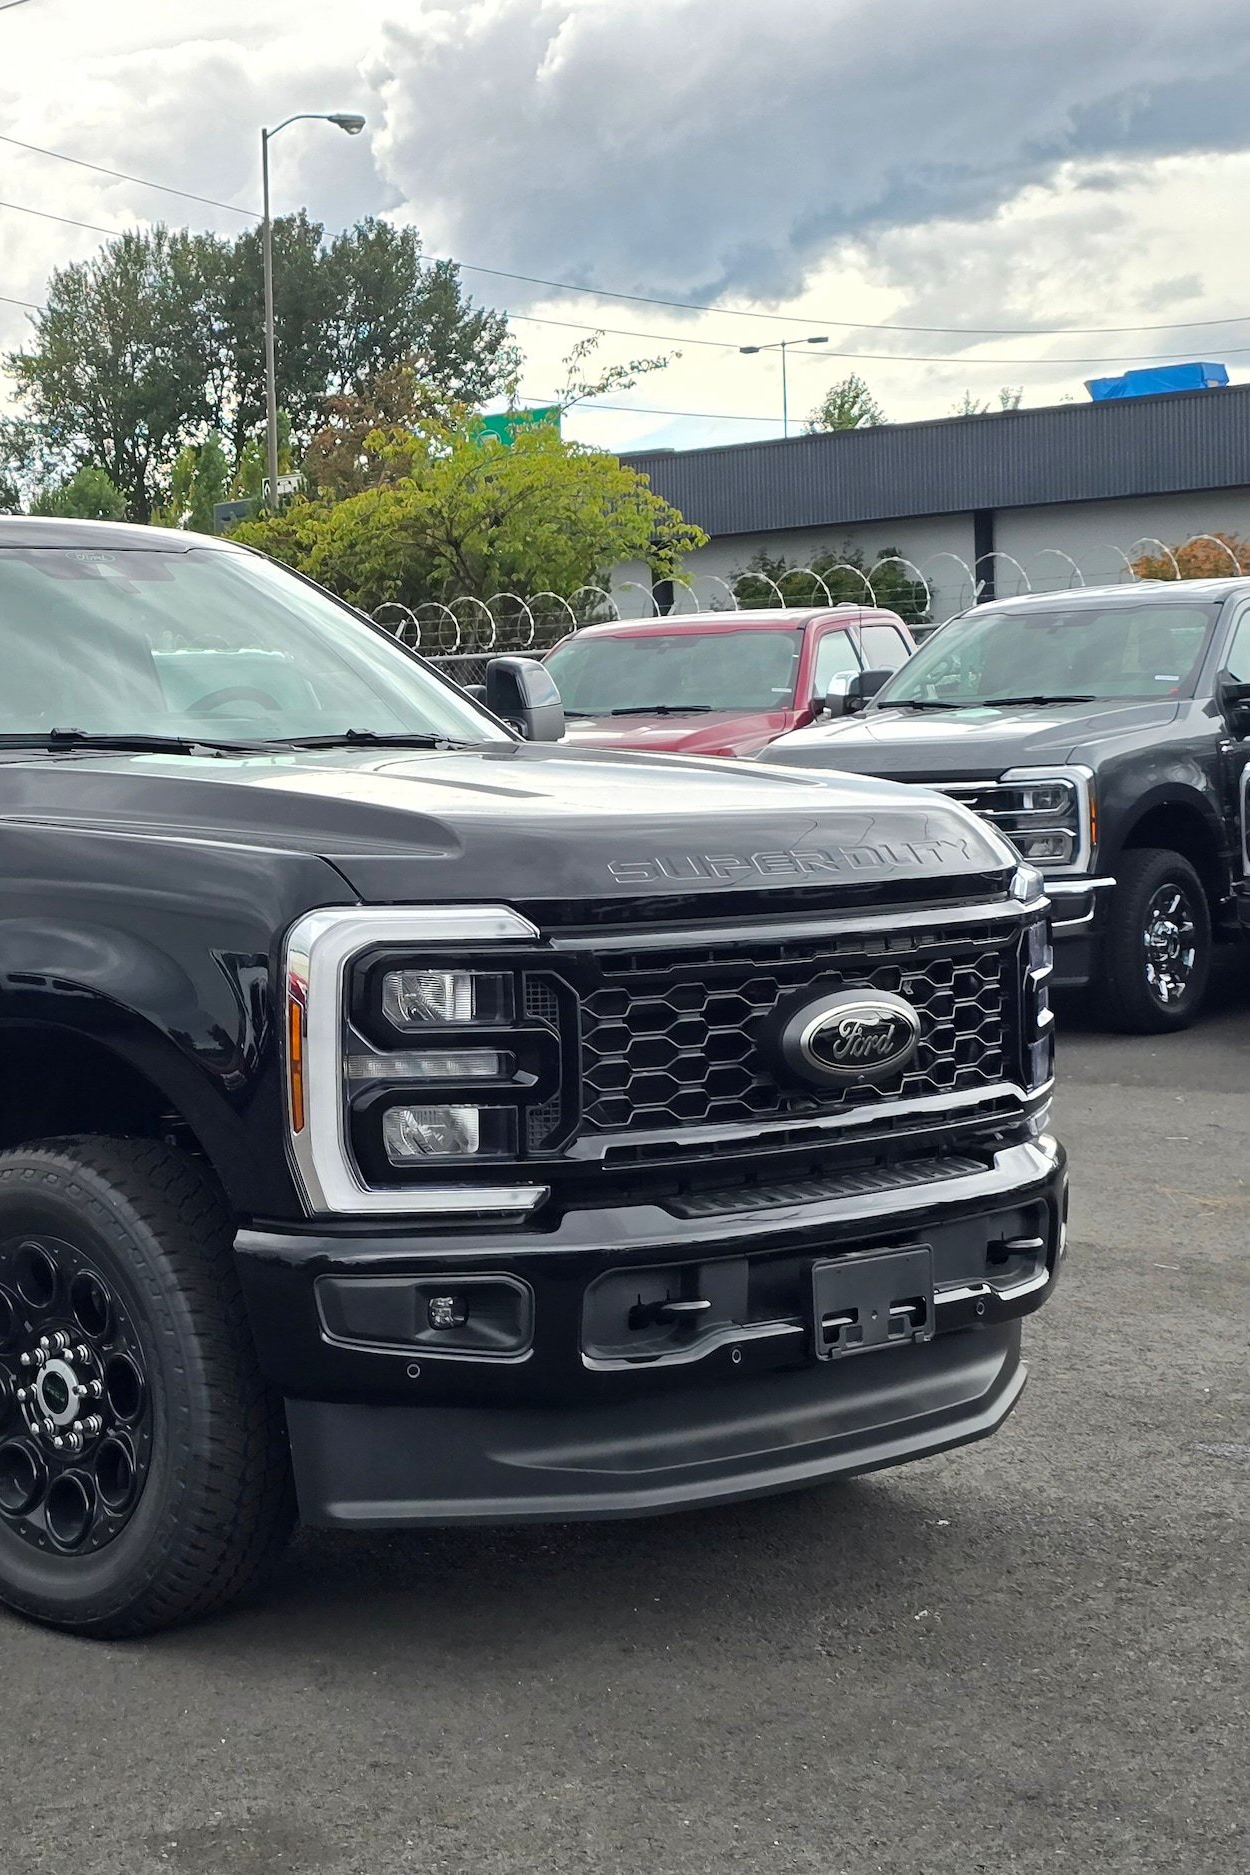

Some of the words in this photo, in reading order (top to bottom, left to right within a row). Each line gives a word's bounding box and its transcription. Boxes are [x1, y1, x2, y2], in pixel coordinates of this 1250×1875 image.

[606, 848, 842, 884] SUPER
[841, 838, 972, 871] DUTY
[833, 1018, 895, 1060] Ford
